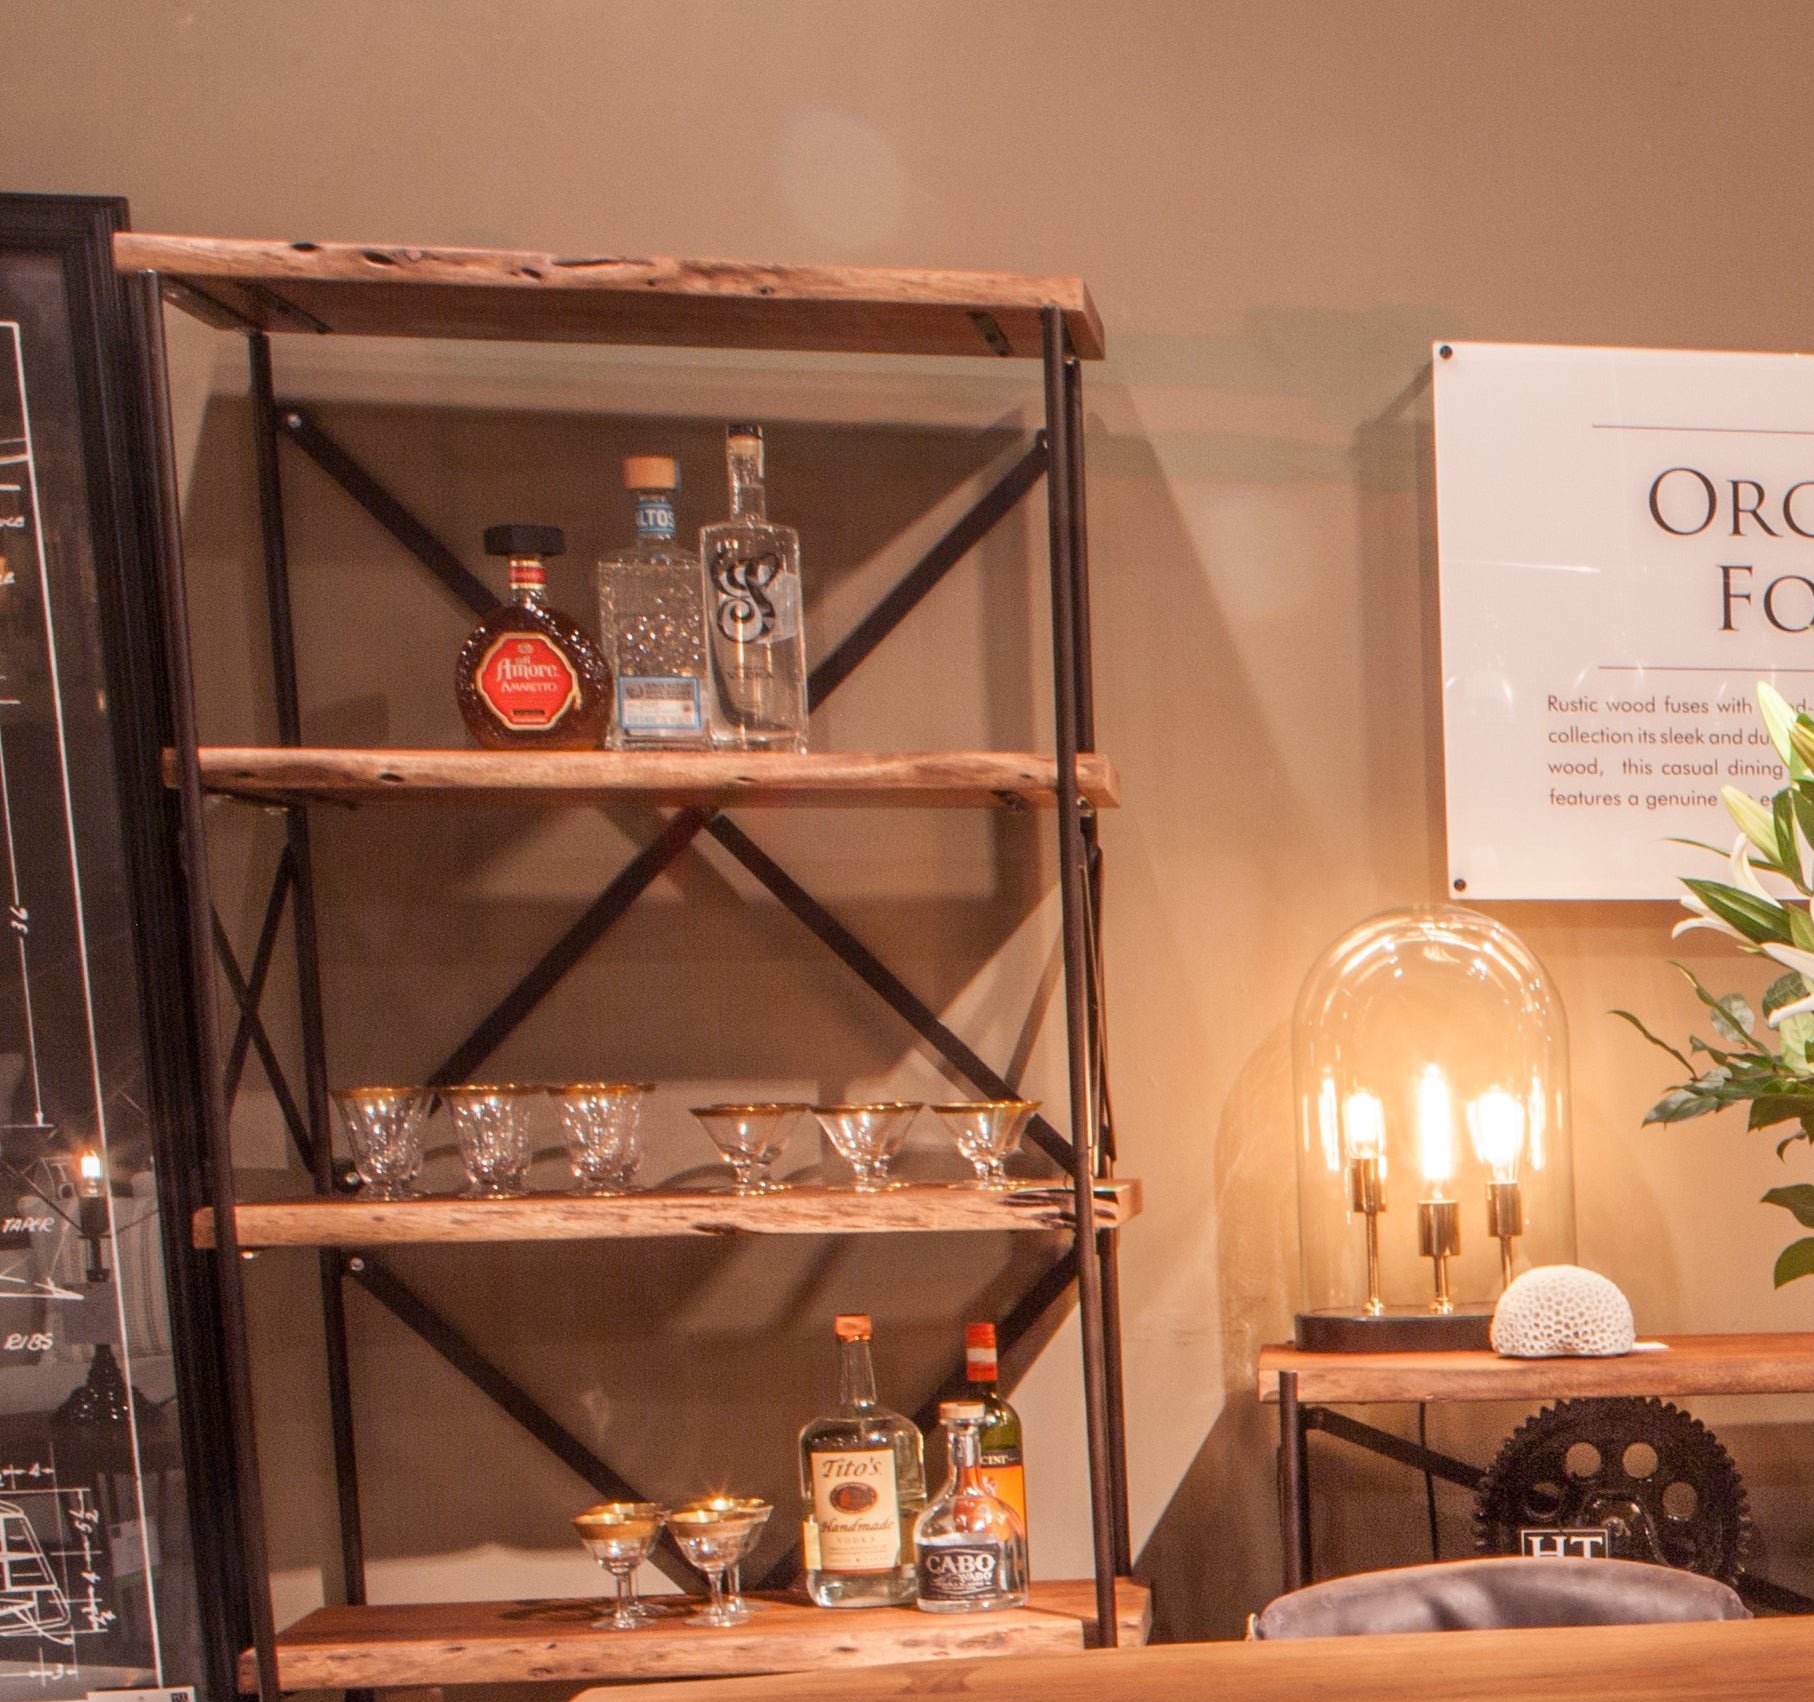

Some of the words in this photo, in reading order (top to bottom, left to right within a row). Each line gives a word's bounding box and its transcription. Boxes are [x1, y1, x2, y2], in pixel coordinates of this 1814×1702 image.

[636, 509, 676, 528] LTOS
[1547, 695, 1598, 713] Rustic
[1606, 697, 1656, 714] wood
[1665, 696, 1709, 714] fuses
[1717, 697, 1752, 715] with
[1548, 727, 1633, 745] collection
[1638, 728, 1656, 745] its
[1660, 727, 1704, 745] sleek
[1709, 728, 1743, 746] and
[1547, 758, 1604, 777] wood,
[1622, 758, 1652, 776] this
[1661, 758, 1718, 776] casual
[1727, 759, 1783, 780] dining
[1550, 787, 1621, 807] features
[1628, 793, 1639, 807] a
[1646, 789, 1717, 810] genuine
[822, 1457, 882, 1478] Tito's
[1528, 1536, 1603, 1558] HT
[926, 1554, 996, 1575] CABO
